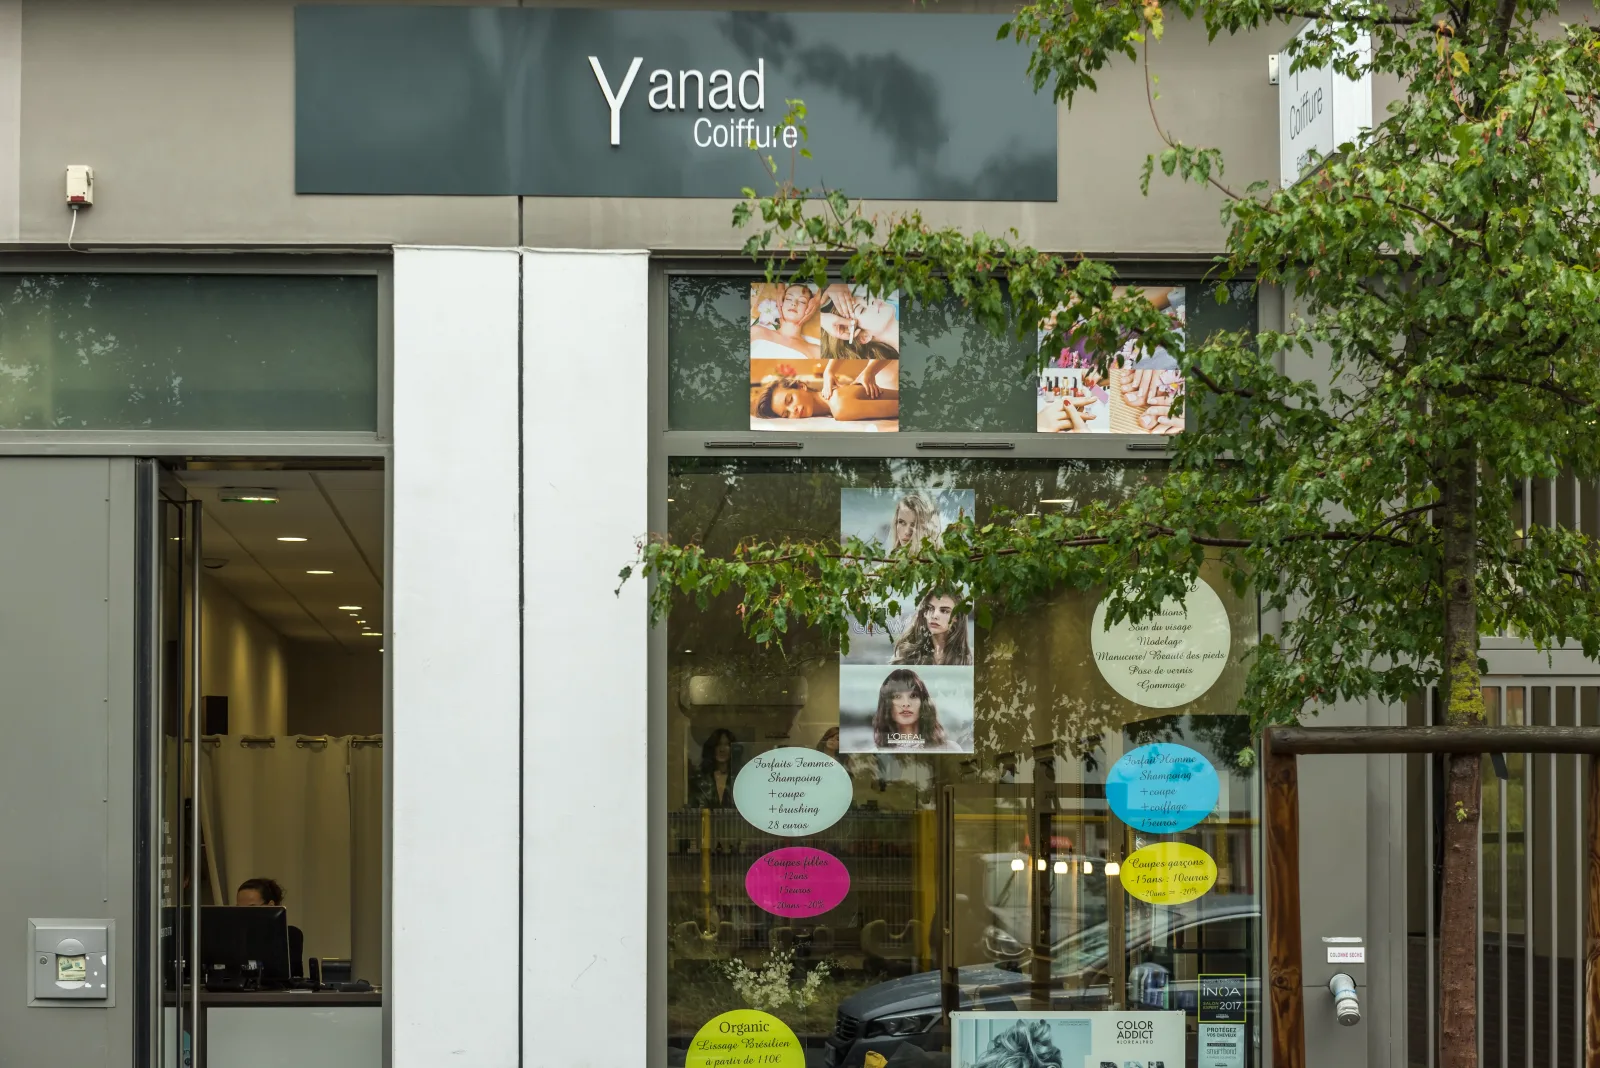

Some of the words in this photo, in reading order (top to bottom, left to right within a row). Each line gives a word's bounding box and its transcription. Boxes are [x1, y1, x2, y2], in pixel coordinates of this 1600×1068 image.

[588, 56, 765, 146] Yanad
[1289, 87, 1323, 140] Coiffure
[693, 117, 798, 148] Coiffure
[1128, 622, 1149, 632] Soin
[1151, 622, 1163, 632] du
[1165, 624, 1192, 633] visage
[1137, 636, 1184, 648] Modelage
[1149, 650, 1184, 661] Beauté
[1186, 651, 1200, 660] des
[1202, 650, 1226, 662] pieds
[1128, 664, 1152, 675] Pose
[1154, 665, 1165, 675] de
[1167, 666, 1194, 675] vernis
[1136, 679, 1186, 692] Gommage
[754, 758, 793, 771] Forfaits
[795, 758, 835, 768] Femmes
[1124, 754, 1156, 768] Forfait
[1157, 753, 1197, 763] Homme
[768, 772, 822, 785] Shampoing
[1139, 769, 1192, 782] Shampoing
[768, 789, 806, 800] +coupe
[1140, 788, 1178, 799] +coupe
[768, 803, 821, 816] +brushing
[1141, 801, 1188, 814] +coiffage
[768, 820, 779, 830] 28
[782, 822, 810, 830] euros
[763, 857, 801, 868] Coupes
[803, 855, 829, 869] filles
[1128, 858, 1166, 871] Coupes
[1168, 859, 1205, 871] garçons
[1130, 874, 1164, 884] -15ans
[1173, 873, 1211, 883] 10euros
[1141, 889, 1167, 898] -20ans
[1179, 886, 1199, 896] -20%
[1219, 1001, 1242, 1010] 2017
[719, 1020, 770, 1036] Organic
[1116, 1020, 1153, 1030] COLOR
[1116, 1030, 1154, 1040] ADDICT
[696, 1039, 739, 1052] Lissage
[741, 1037, 791, 1049] Brésilien
[705, 1057, 712, 1066] à
[714, 1056, 742, 1068] partir
[743, 1055, 755, 1065] de
[758, 1054, 782, 1065] 110€
